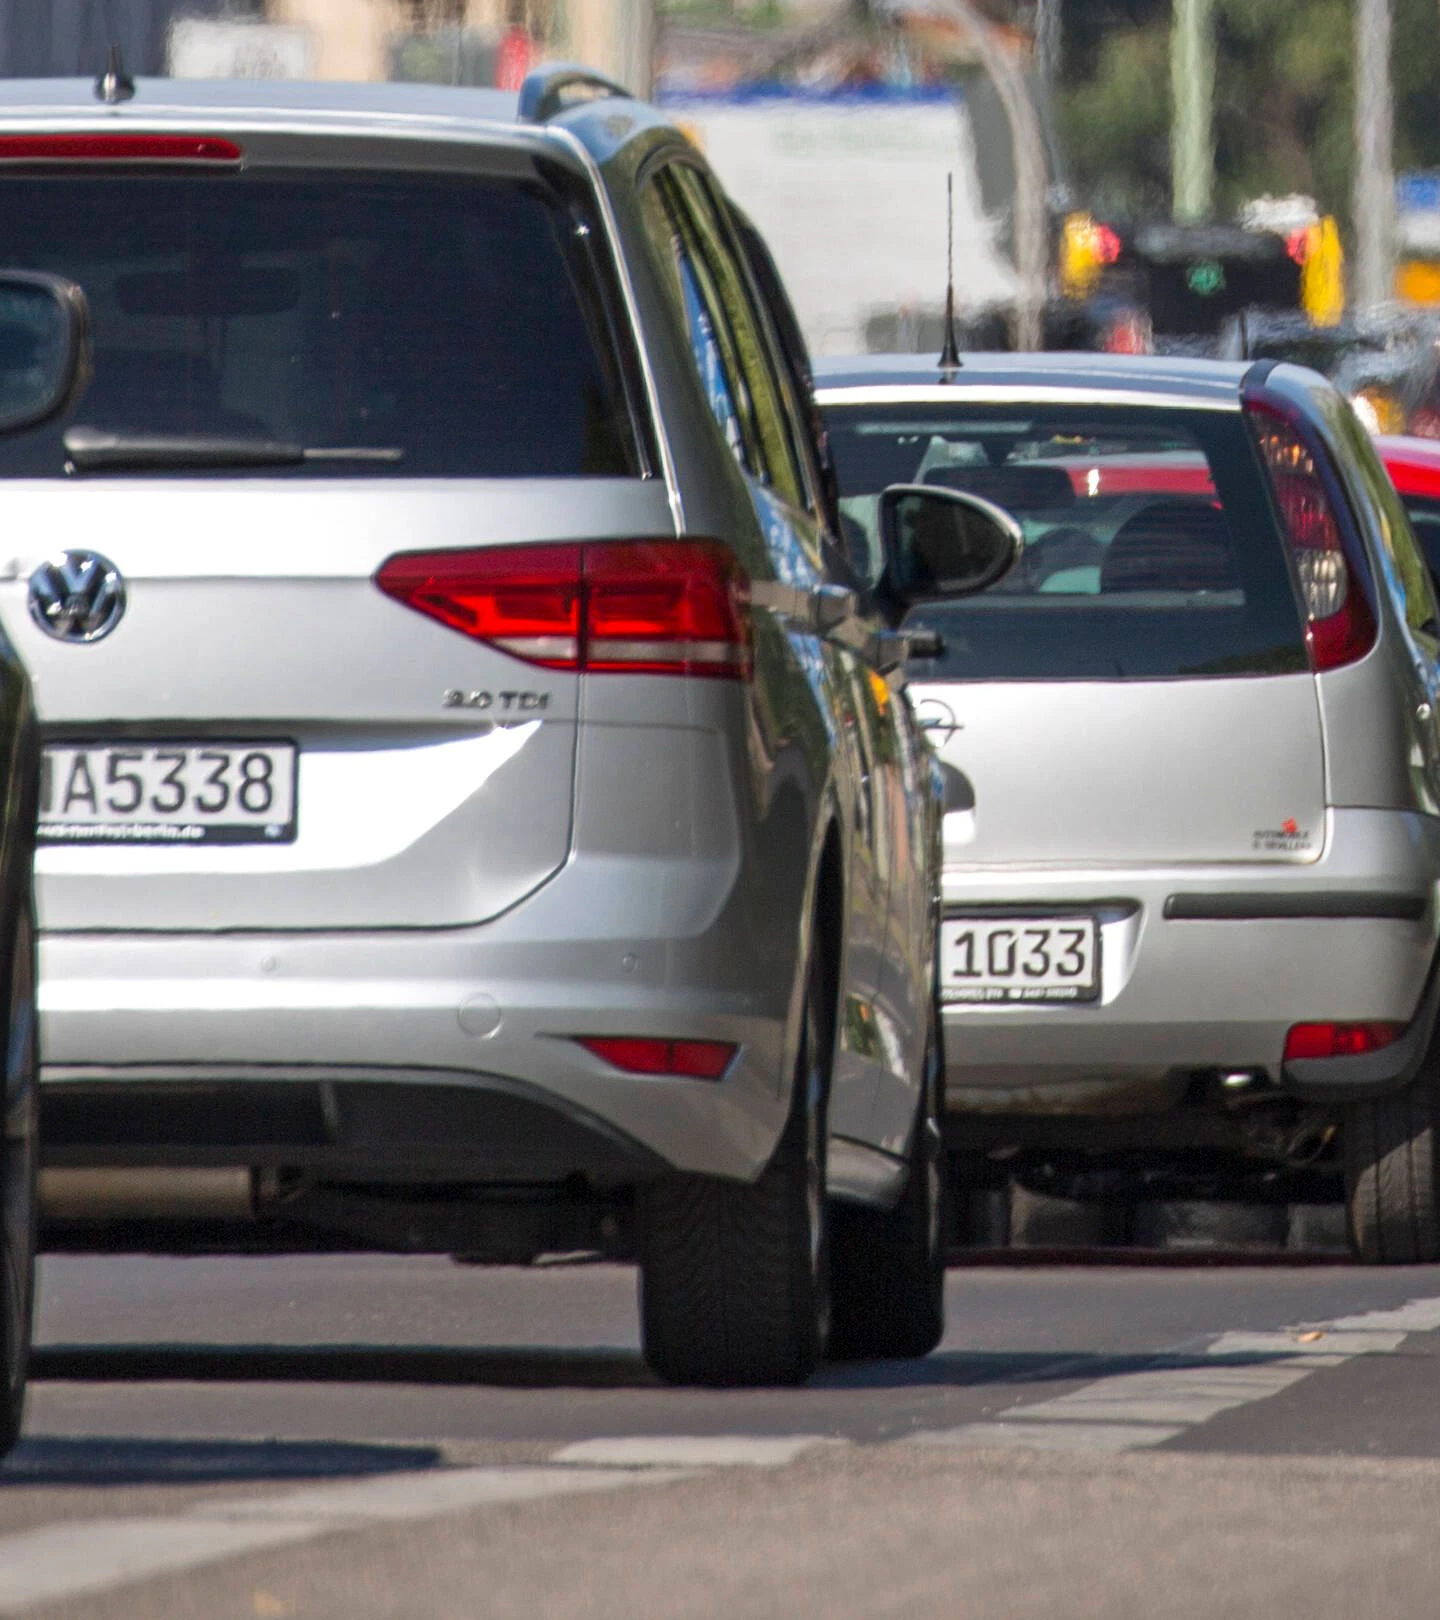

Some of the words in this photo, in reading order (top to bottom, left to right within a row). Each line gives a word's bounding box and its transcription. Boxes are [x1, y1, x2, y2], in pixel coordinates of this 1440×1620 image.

[498, 690, 550, 710] TDI
[40, 753, 274, 814] A5338
[952, 928, 1086, 978] 1033
